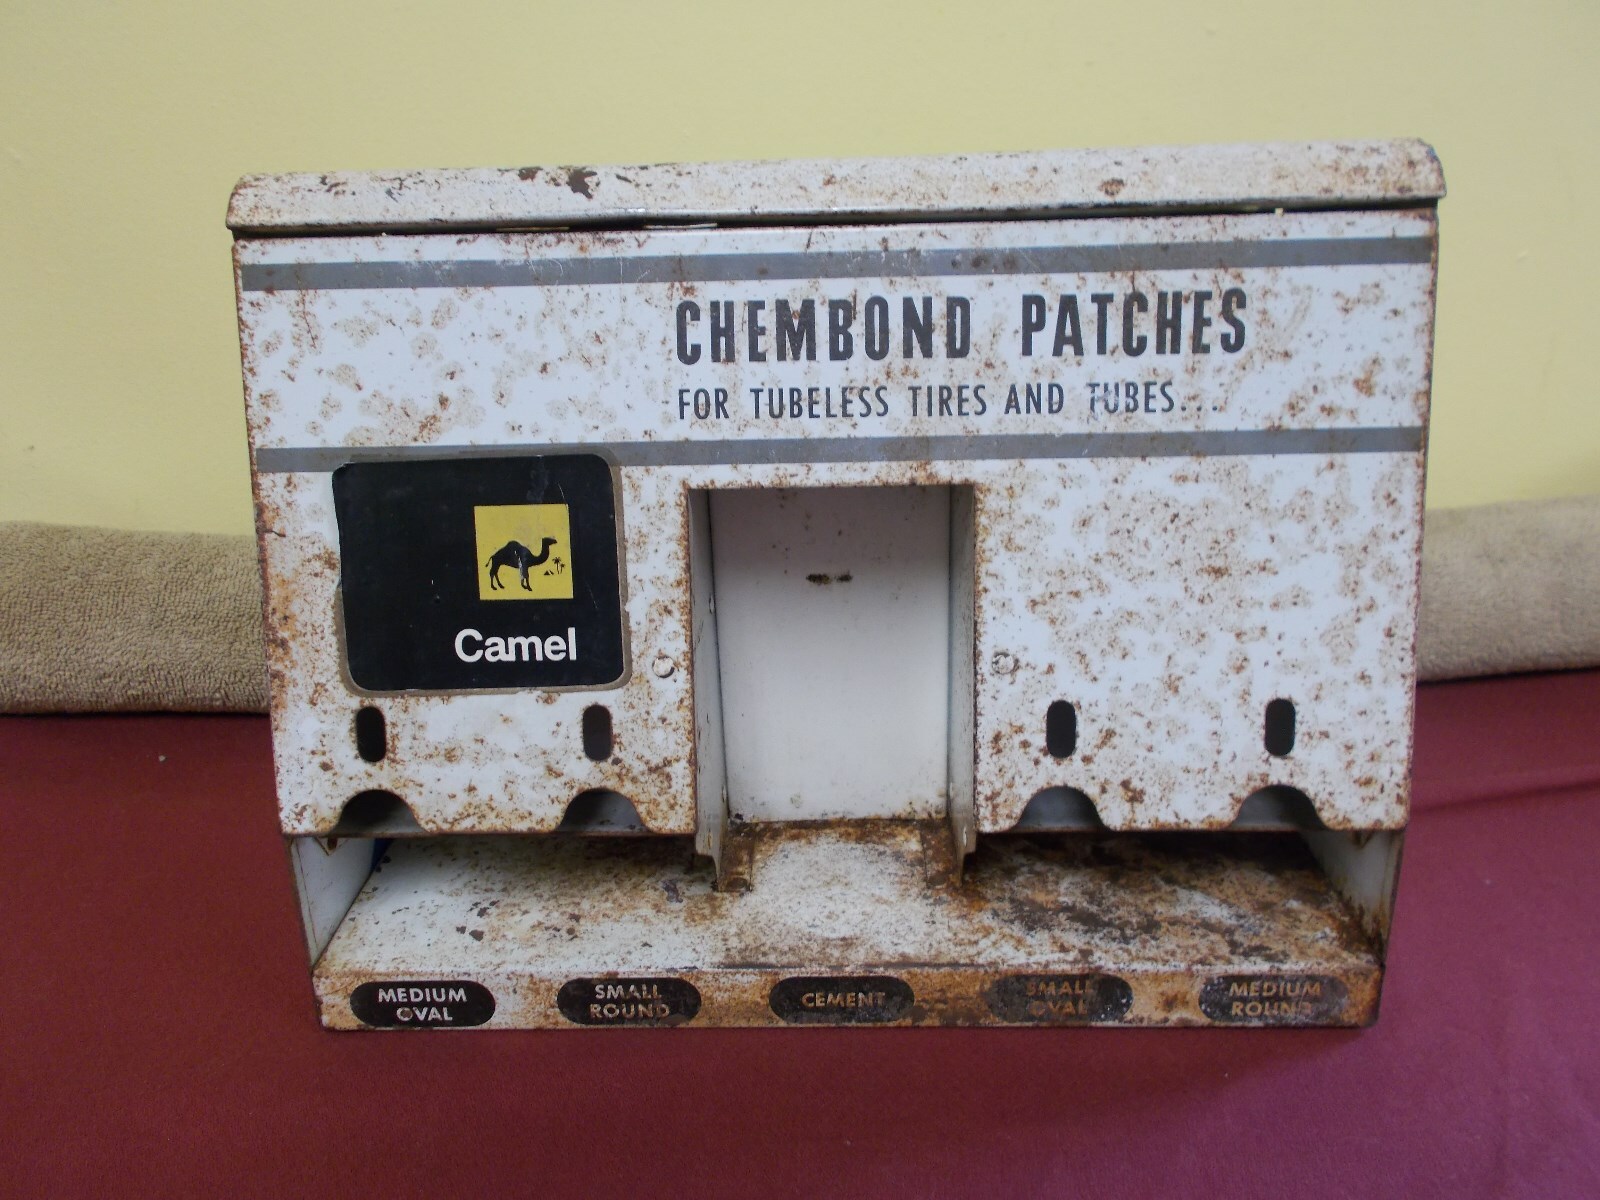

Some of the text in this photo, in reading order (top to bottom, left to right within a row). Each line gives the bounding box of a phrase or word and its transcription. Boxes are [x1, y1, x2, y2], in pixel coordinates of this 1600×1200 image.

[675, 287, 1248, 365] CHEMBOND PATCHES
[678, 387, 729, 420] FOR
[750, 384, 890, 419] TUBELESS
[908, 383, 987, 417] TIRES
[1004, 382, 1064, 415] AND
[454, 627, 577, 662] Camel
[378, 987, 468, 1003] MEDIUM
[594, 984, 662, 999] SMALL
[1229, 981, 1321, 997] MEDIUM
[801, 991, 886, 1008] CEMENT
[396, 1006, 454, 1021] OVAL
[589, 1003, 671, 1019] ROUND
